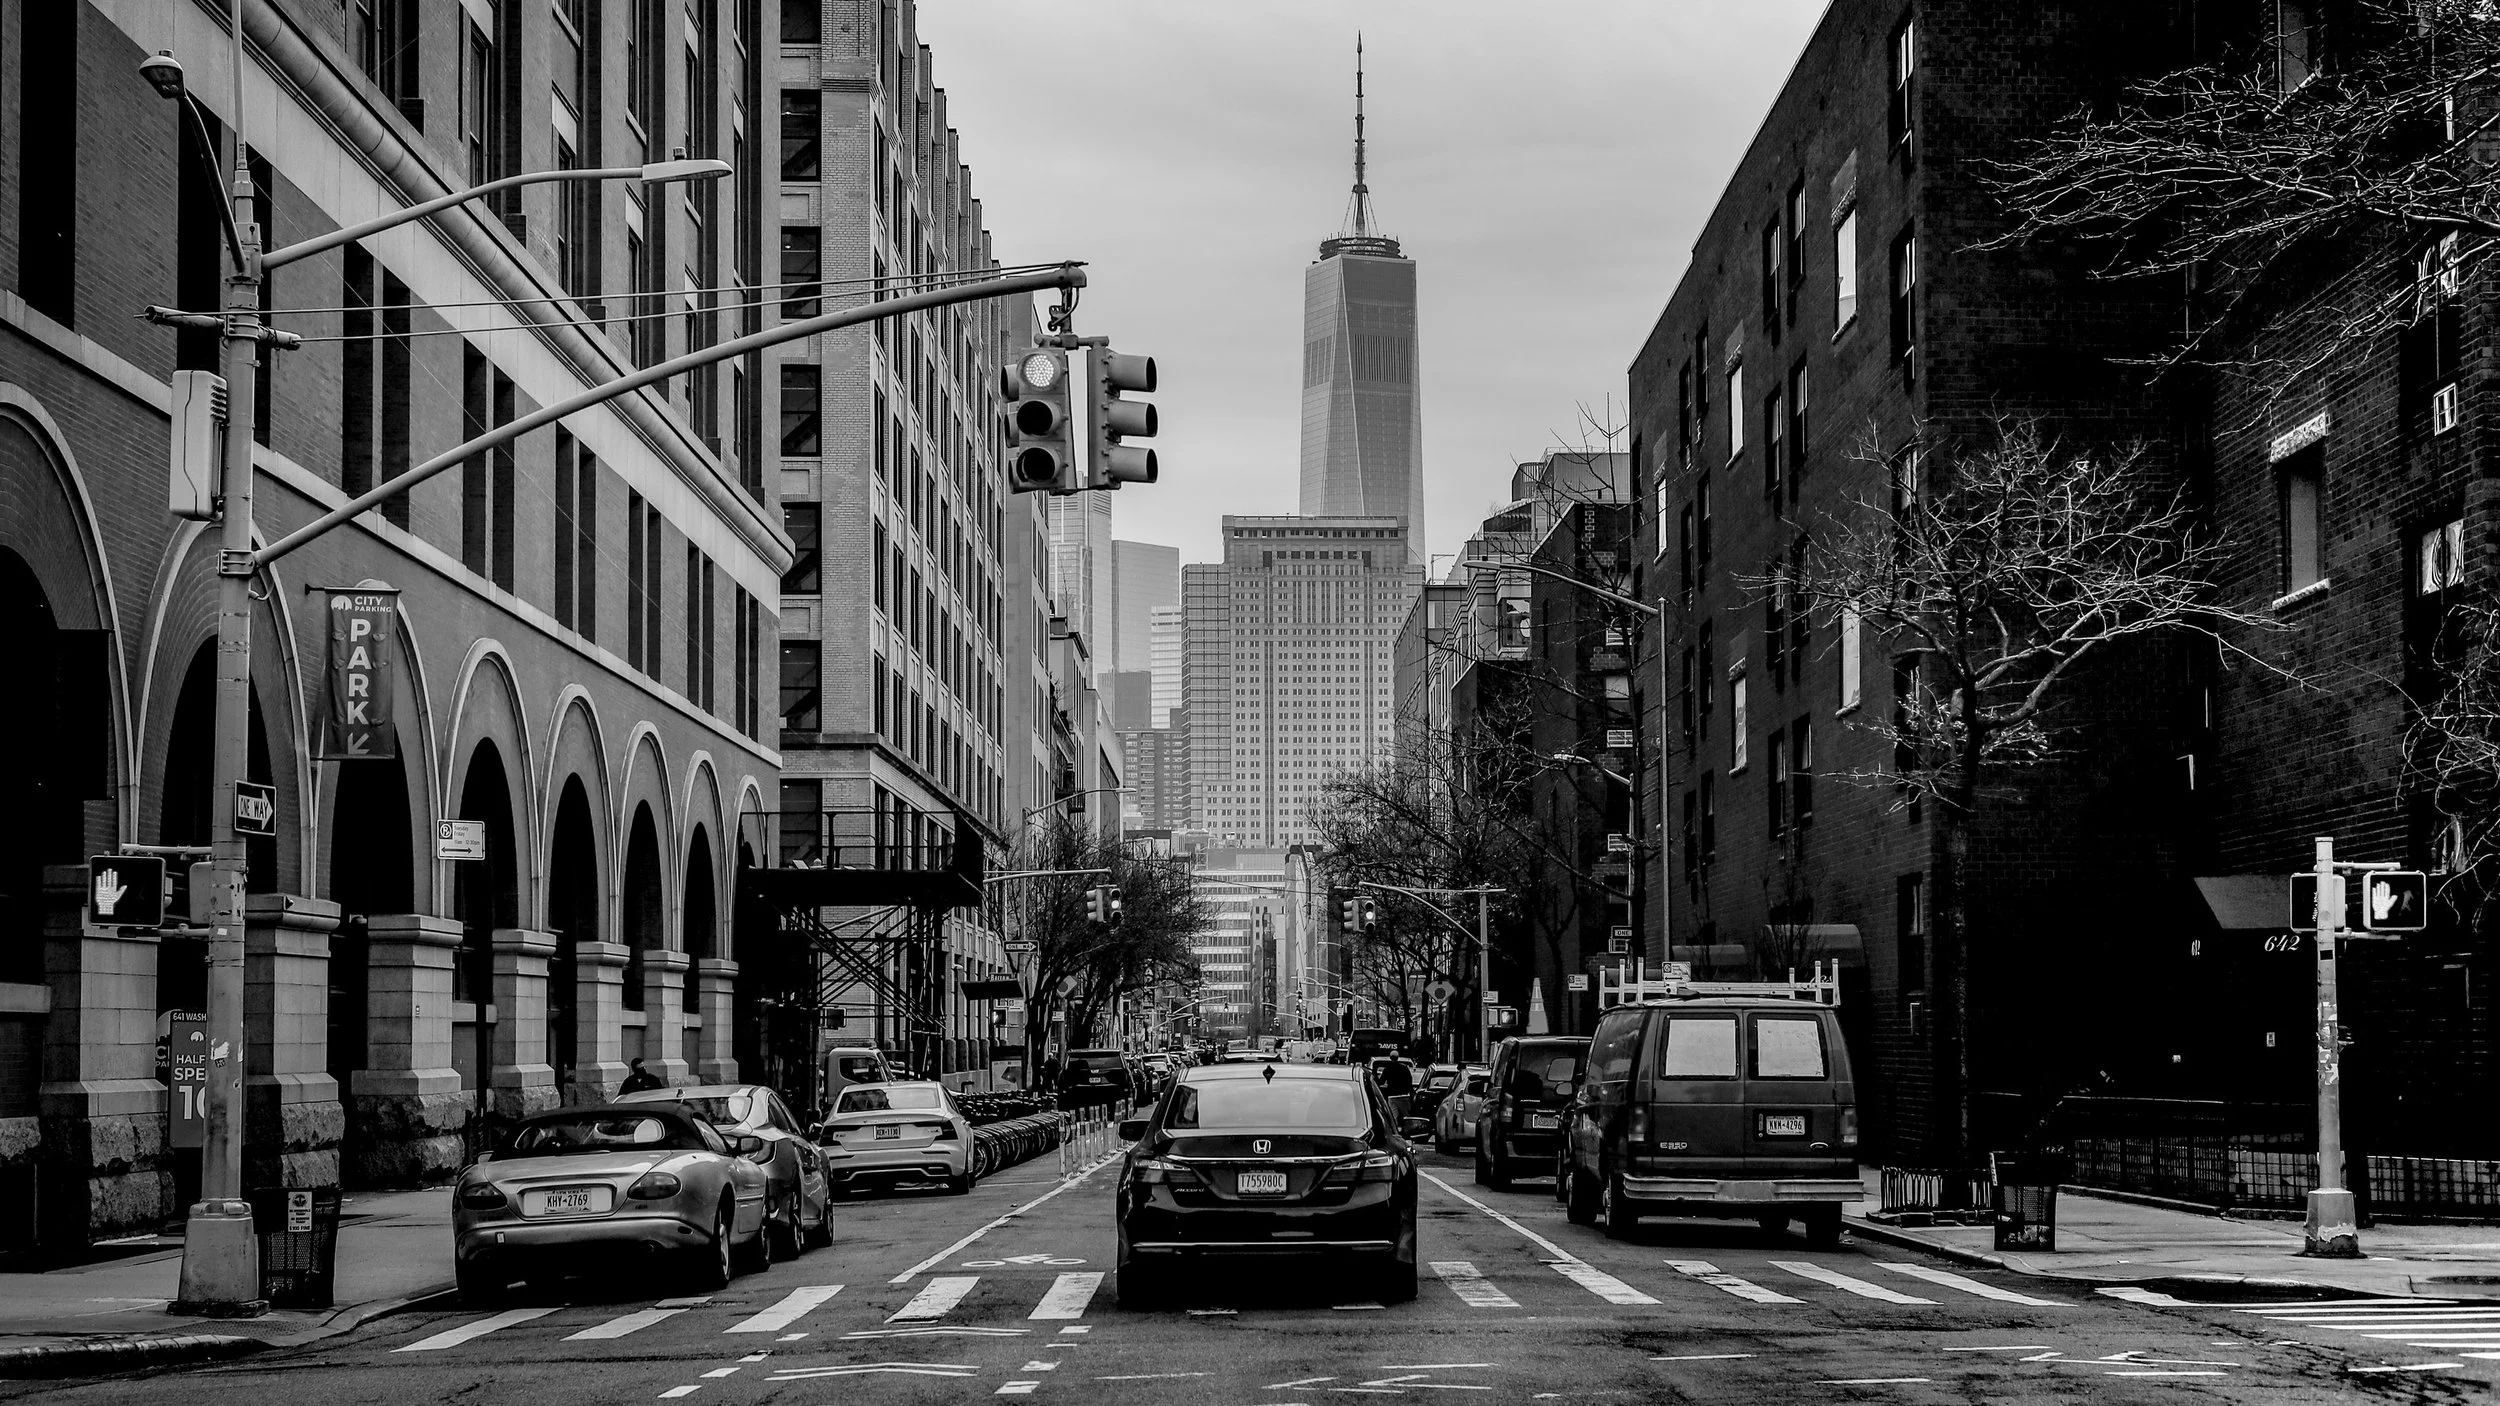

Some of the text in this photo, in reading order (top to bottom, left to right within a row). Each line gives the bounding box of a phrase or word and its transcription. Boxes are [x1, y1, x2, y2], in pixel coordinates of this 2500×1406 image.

[355, 596, 383, 606] CITY
[347, 618, 372, 725] PARK
[241, 797, 269, 819] ONE WAY
[2264, 934, 2300, 952] 642
[173, 1012, 207, 1021] 641 WASH
[176, 1054, 206, 1064] HALF
[1241, 1173, 1283, 1188] T755980C
